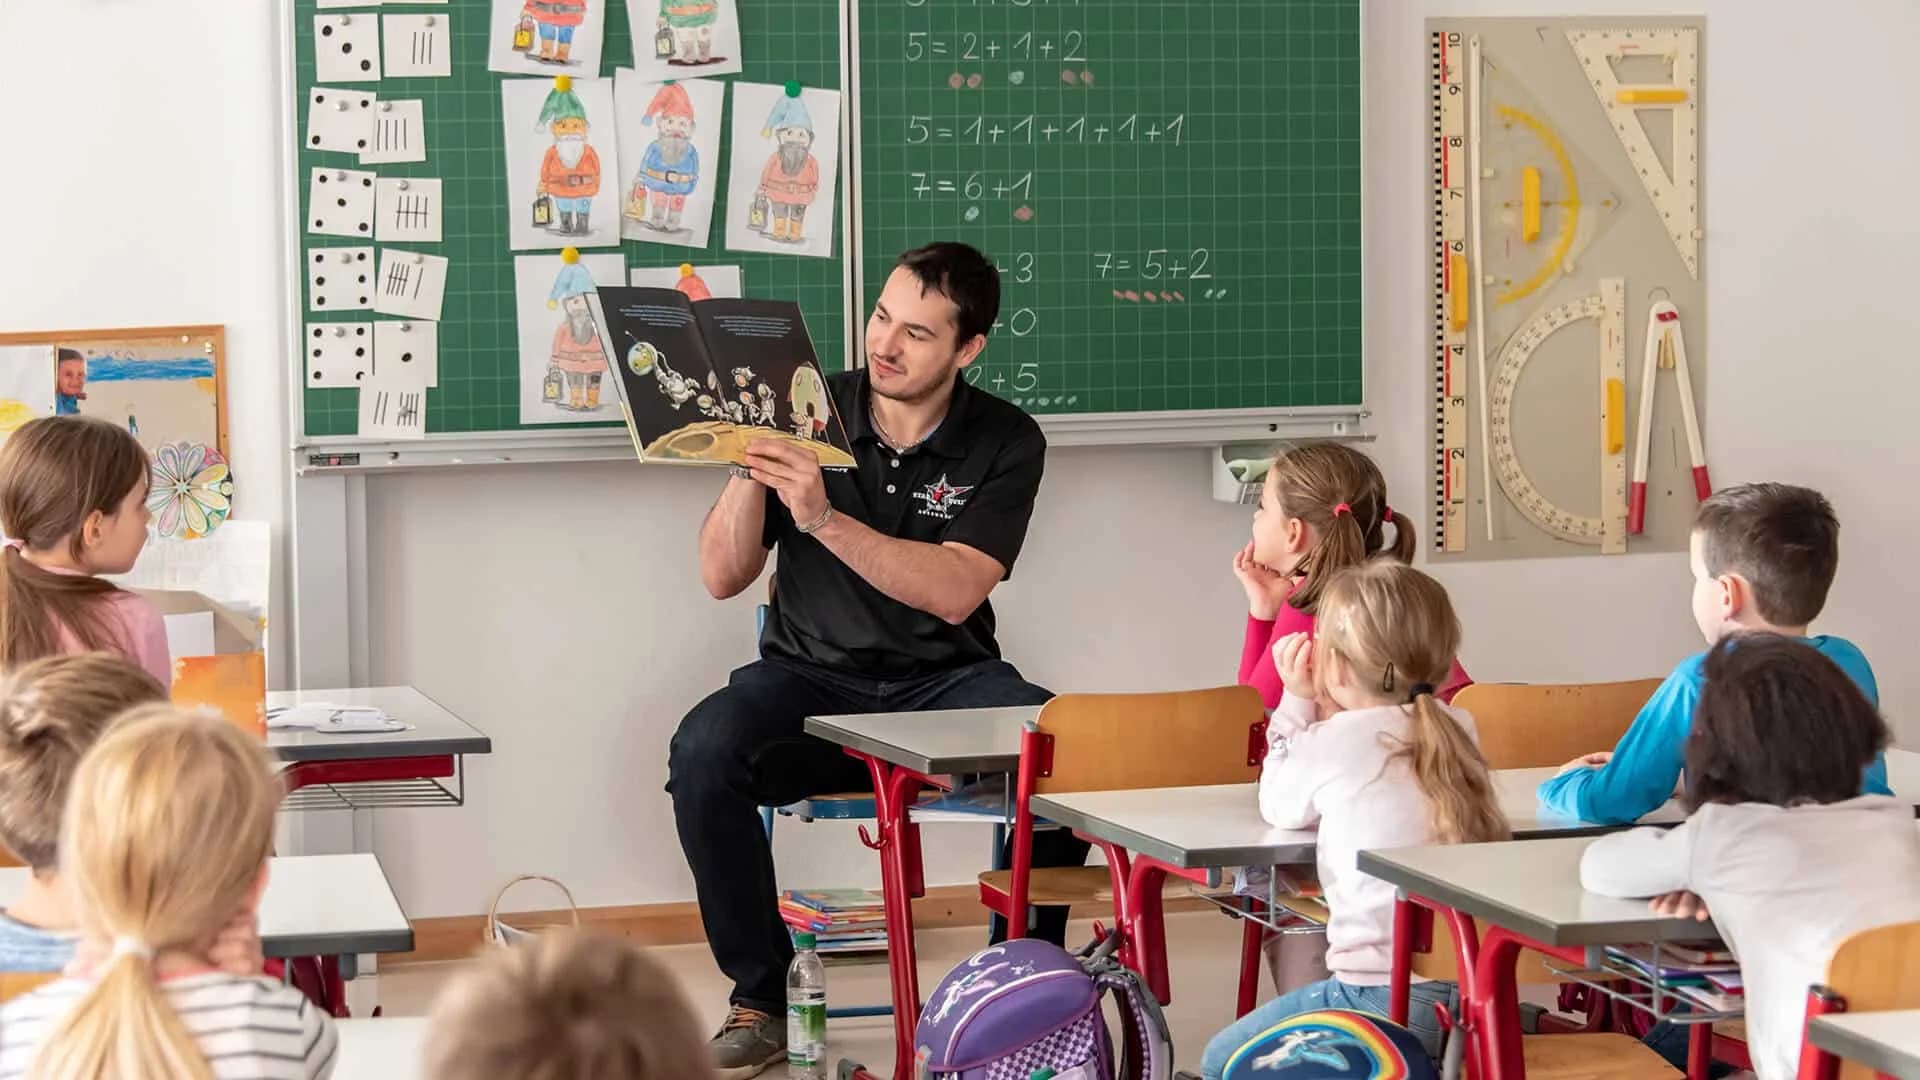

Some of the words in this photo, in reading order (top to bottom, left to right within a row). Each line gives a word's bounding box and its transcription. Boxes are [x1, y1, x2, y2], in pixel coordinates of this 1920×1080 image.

[1447, 32, 1461, 48] 10
[1448, 85, 1462, 96] 9
[1449, 137, 1463, 148] 8
[1449, 190, 1464, 201] 7
[1450, 240, 1464, 252] 6
[1451, 346, 1465, 356] 4
[1451, 397, 1465, 408] 3
[1451, 449, 1465, 460] 2
